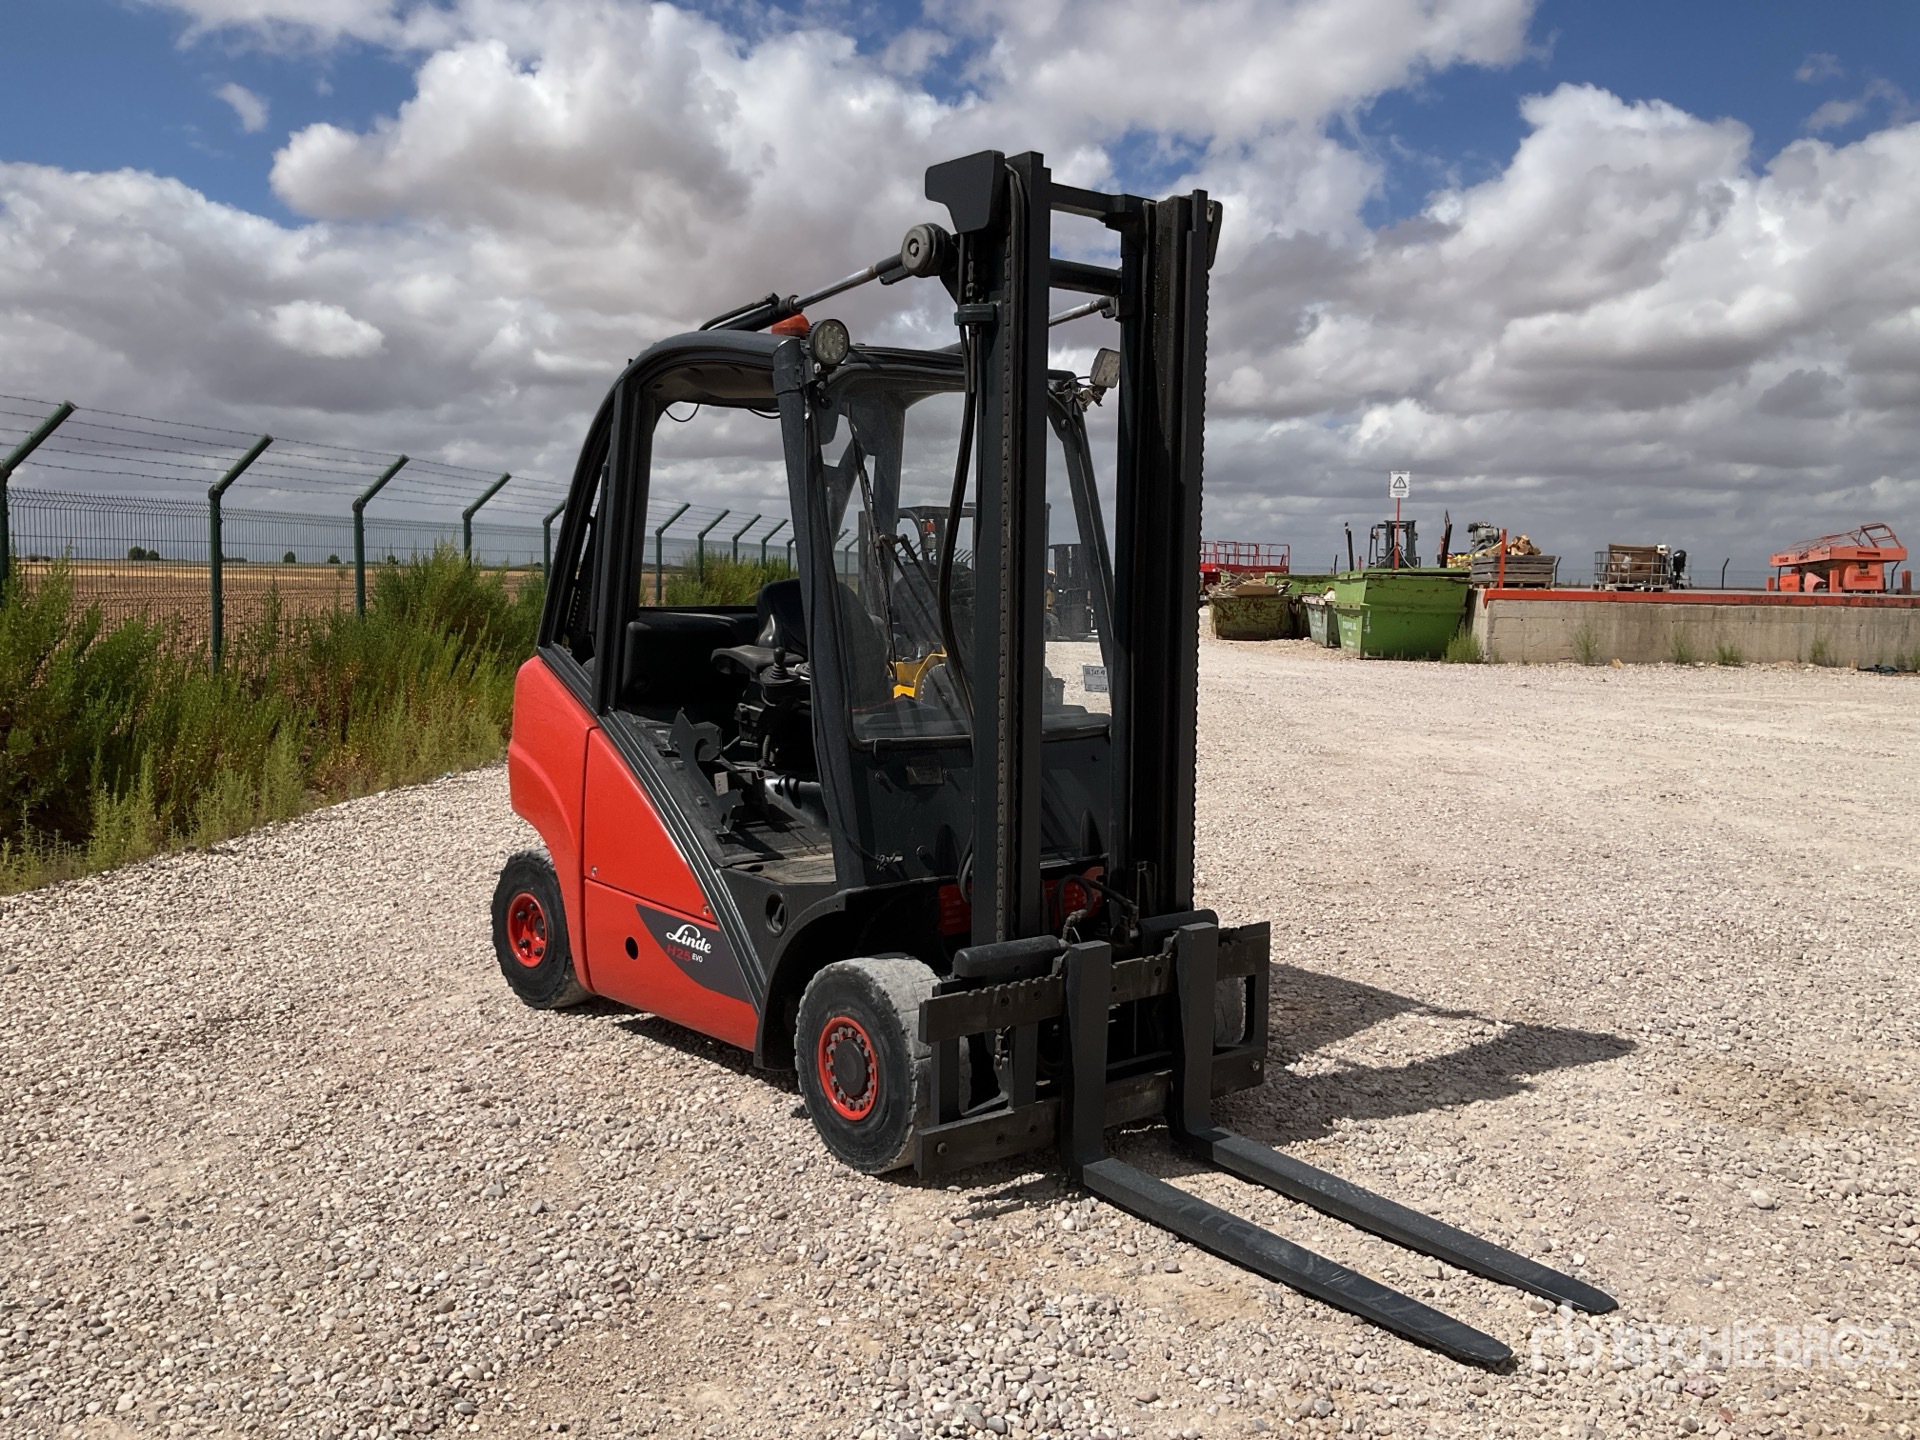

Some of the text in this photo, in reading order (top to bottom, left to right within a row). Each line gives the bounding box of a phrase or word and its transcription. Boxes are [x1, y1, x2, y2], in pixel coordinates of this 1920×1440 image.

[666, 924, 711, 954] Linde
[666, 943, 704, 963] H25 EVO
